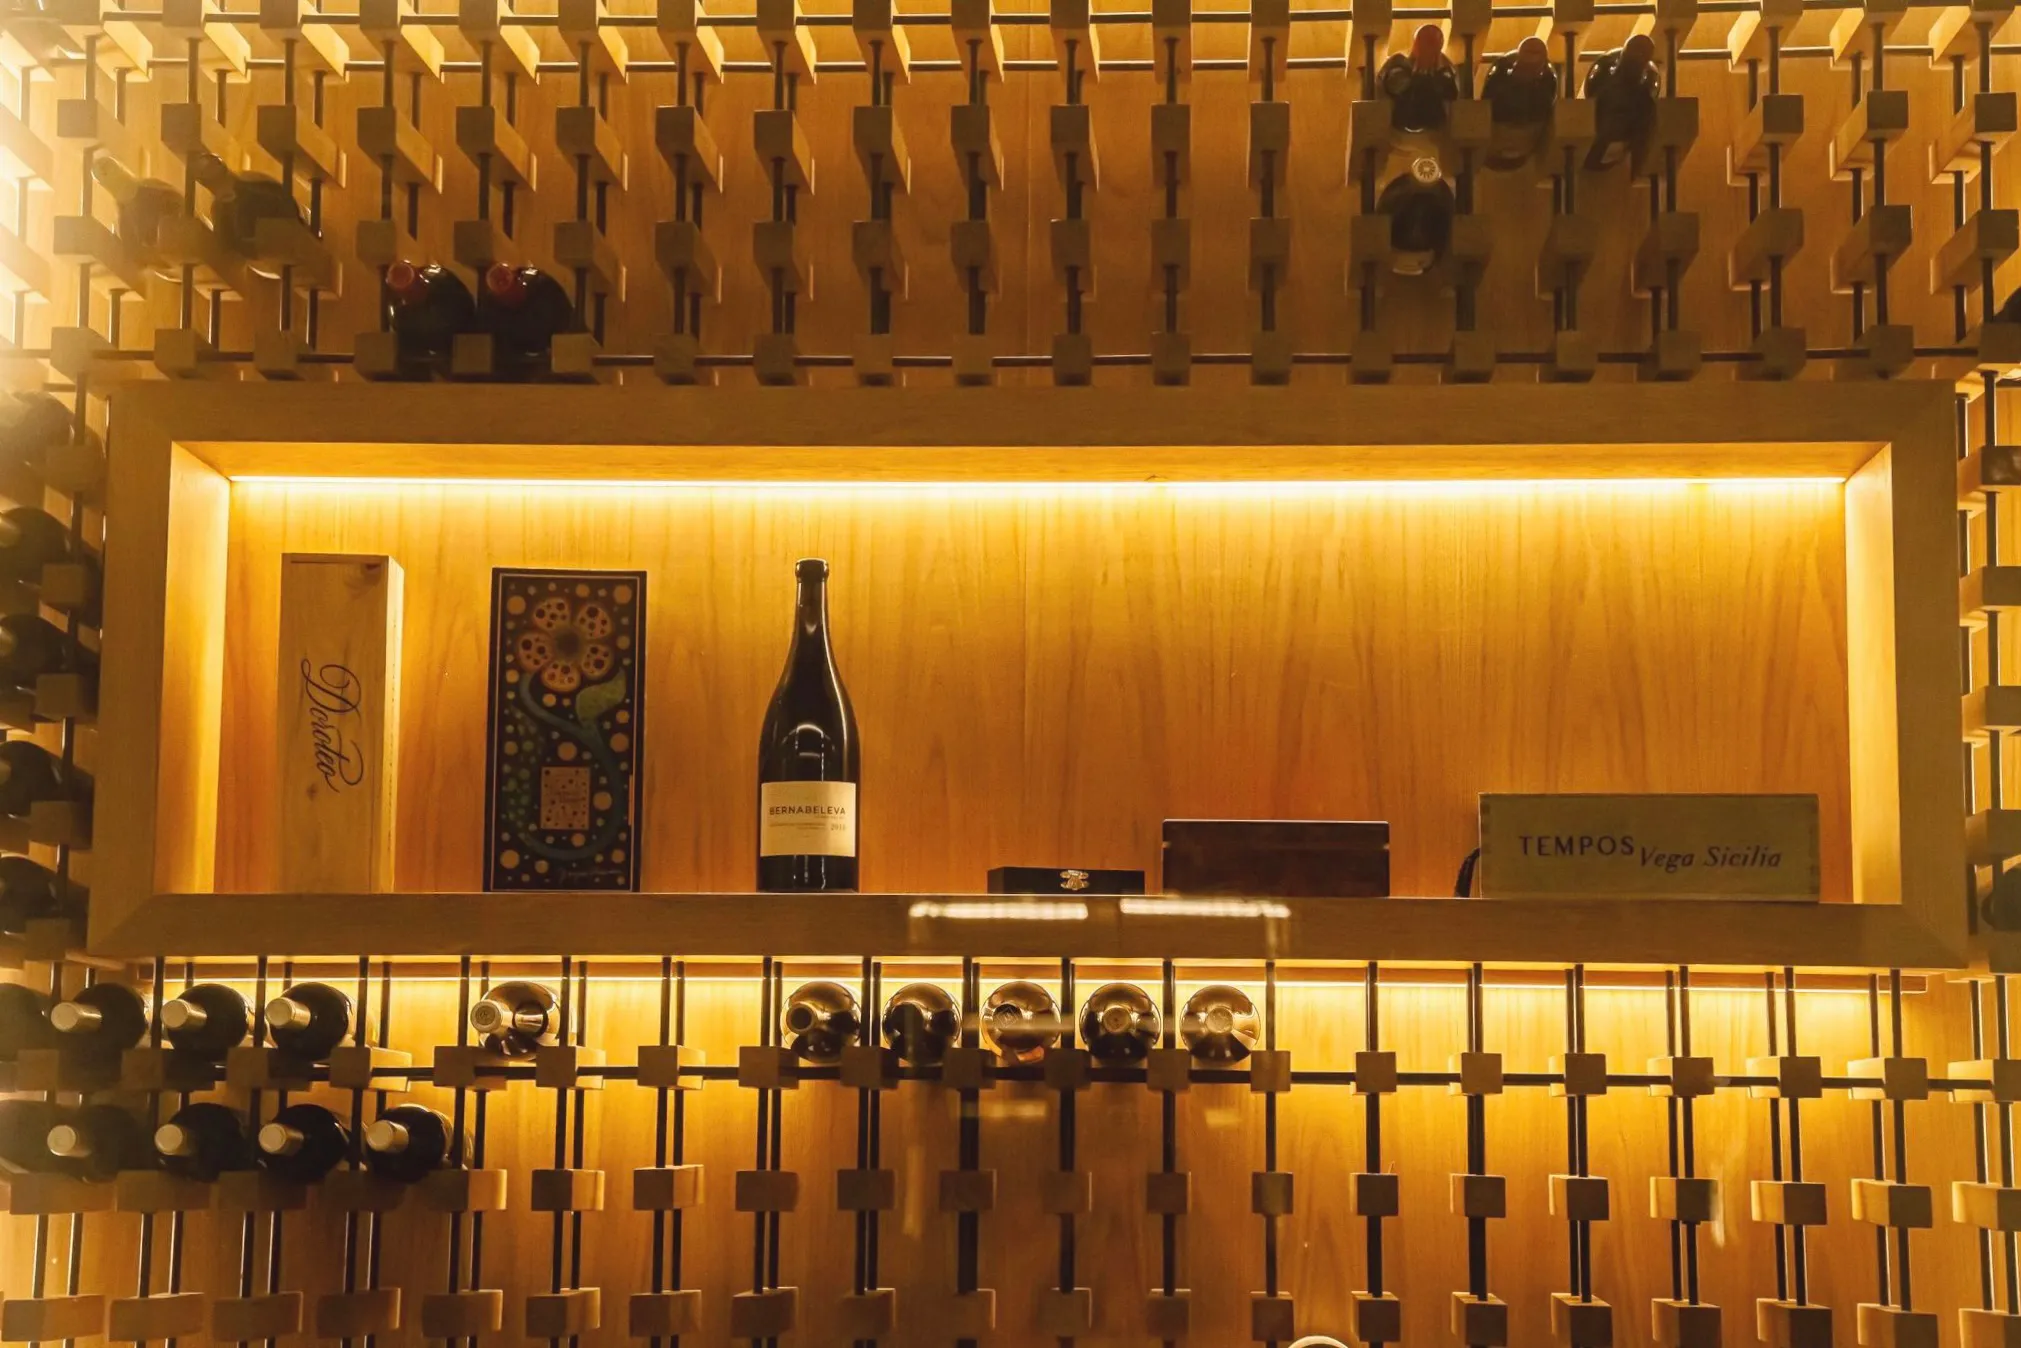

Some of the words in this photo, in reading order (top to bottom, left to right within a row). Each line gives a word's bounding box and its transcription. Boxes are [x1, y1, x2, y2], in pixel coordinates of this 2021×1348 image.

[769, 805, 846, 815] BERNABELEVA
[1519, 835, 1635, 856] TEMPOS
[1640, 846, 1694, 873] Vega
[1704, 846, 1782, 868] Sicilia
